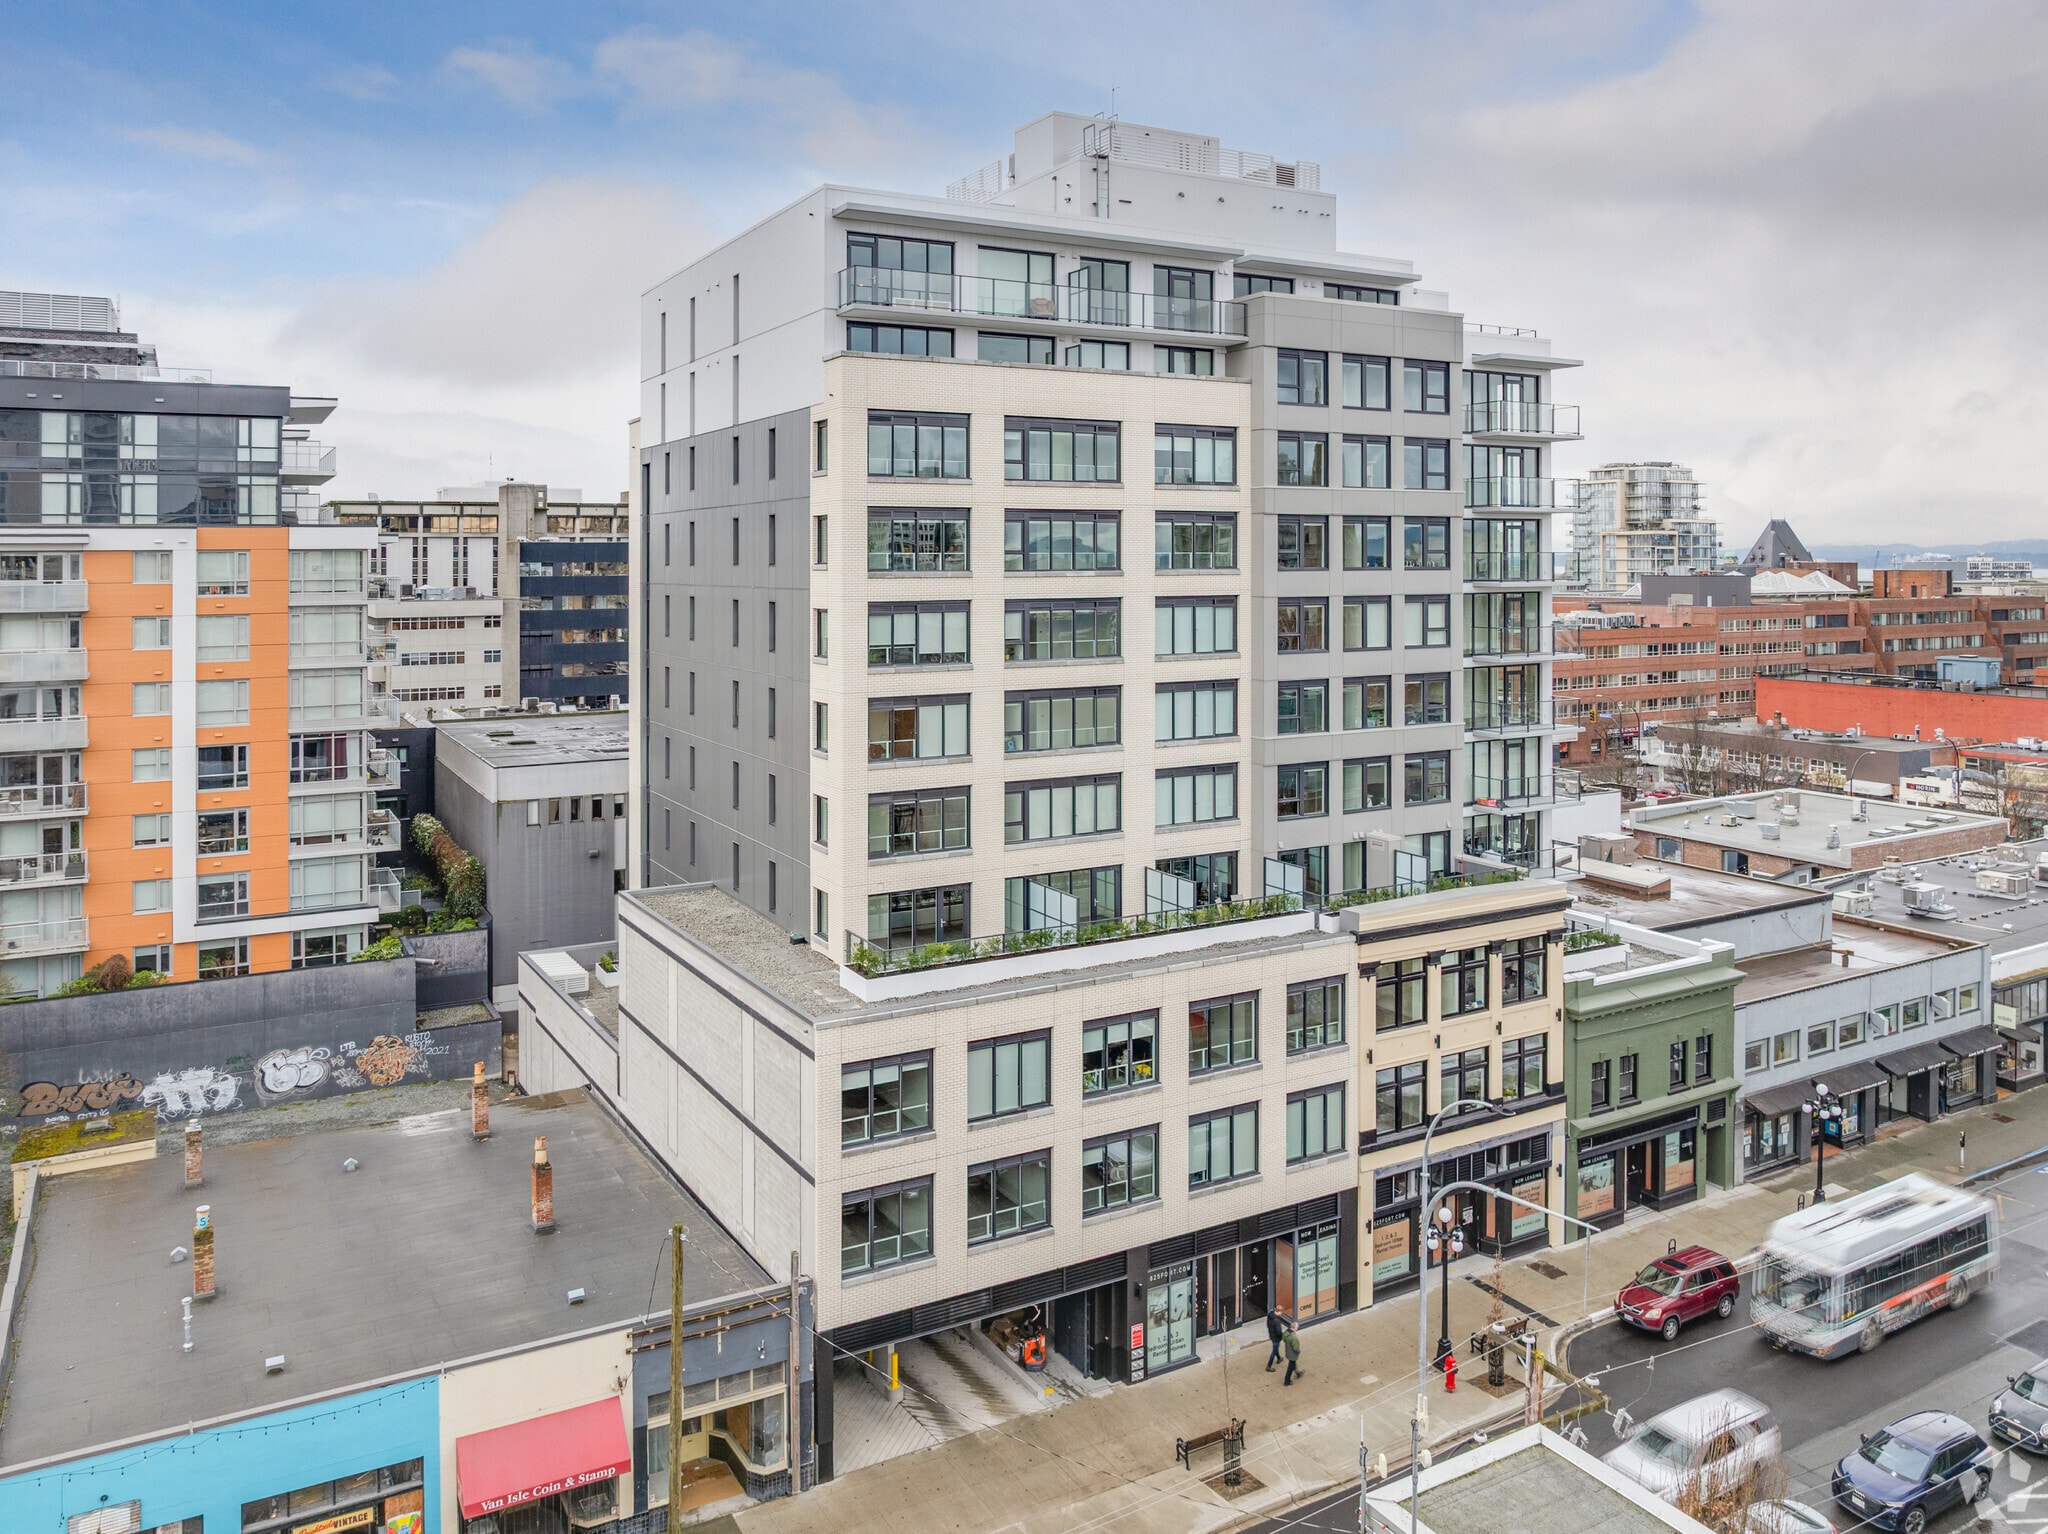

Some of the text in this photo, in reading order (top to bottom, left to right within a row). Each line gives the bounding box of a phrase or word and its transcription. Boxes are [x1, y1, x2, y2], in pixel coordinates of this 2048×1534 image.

[481, 1466, 616, 1512] Van Isle Coin & Stamp
[333, 1512, 368, 1529] VINTAGE
